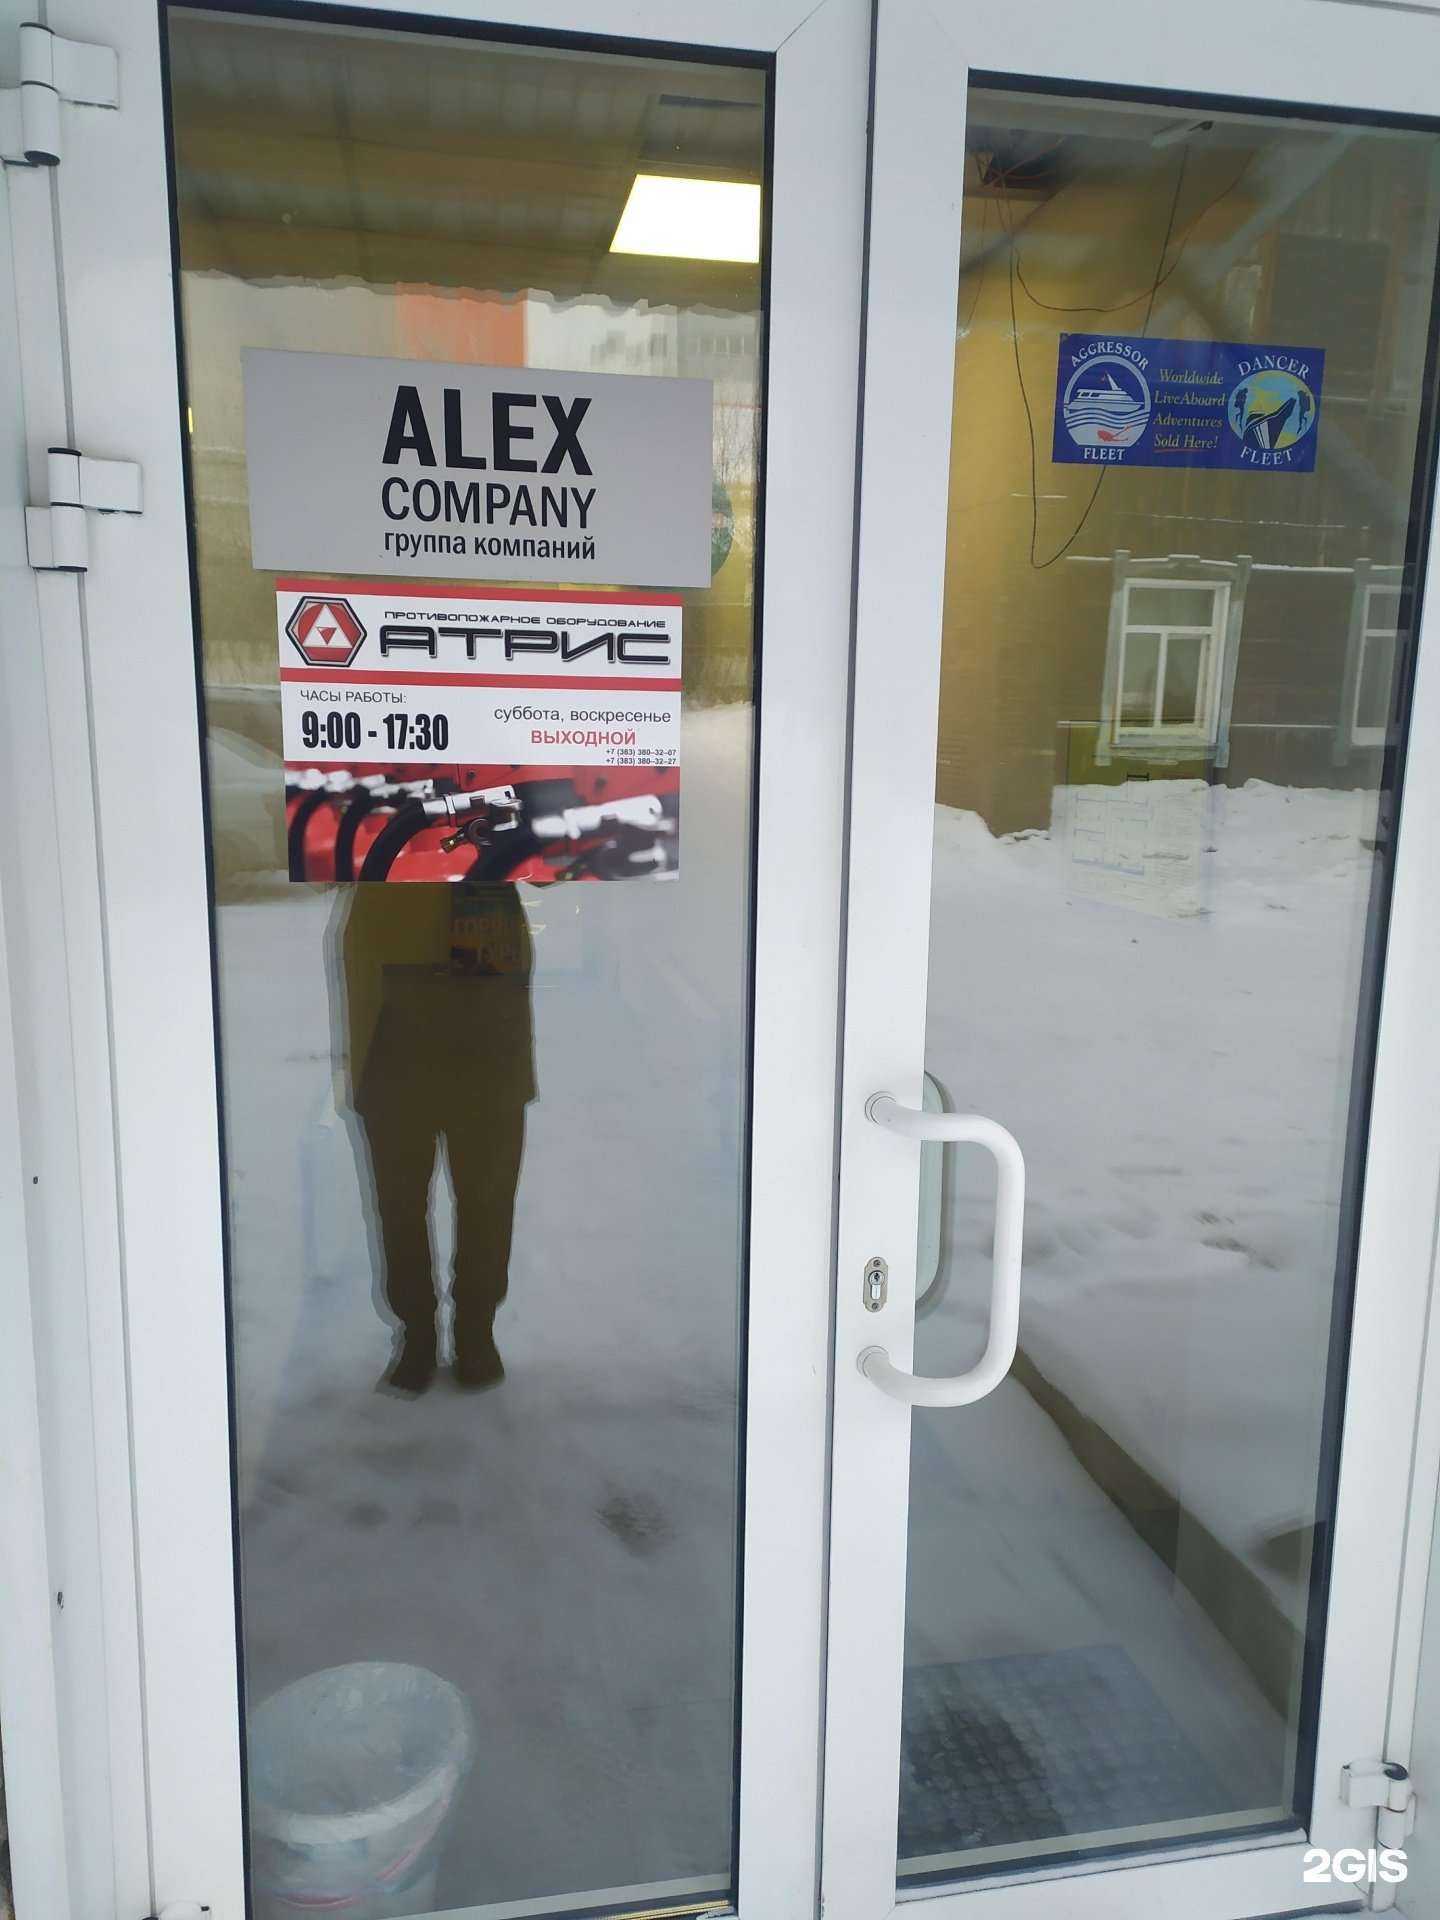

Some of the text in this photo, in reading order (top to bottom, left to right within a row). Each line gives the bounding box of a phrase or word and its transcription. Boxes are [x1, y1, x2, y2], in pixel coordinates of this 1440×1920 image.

[1070, 341, 1151, 372] AGGRESSOR
[1159, 368, 1225, 386] Worldwide
[1237, 354, 1310, 380] DANCER
[381, 384, 594, 476] ALEX
[1153, 412, 1224, 429] Adventures
[1153, 433, 1219, 450] Sold Here!
[1083, 447, 1126, 462] FLEET
[1240, 446, 1294, 466] FLEET
[380, 476, 597, 529] COMPANY
[383, 529, 597, 561] группа компаний
[384, 610, 667, 629] ПРОТИВОПОЖАРНОЕ ОБОРУДОВАНИЕ
[379, 623, 671, 666] АТРИС
[300, 689, 408, 704] ЧАСЫ РАБОТЫ:
[493, 706, 672, 726] суббота, воскресенье
[301, 710, 362, 750] 9:00
[382, 712, 449, 751] 17:30
[530, 727, 637, 748] ВЫХОДНОЙ
